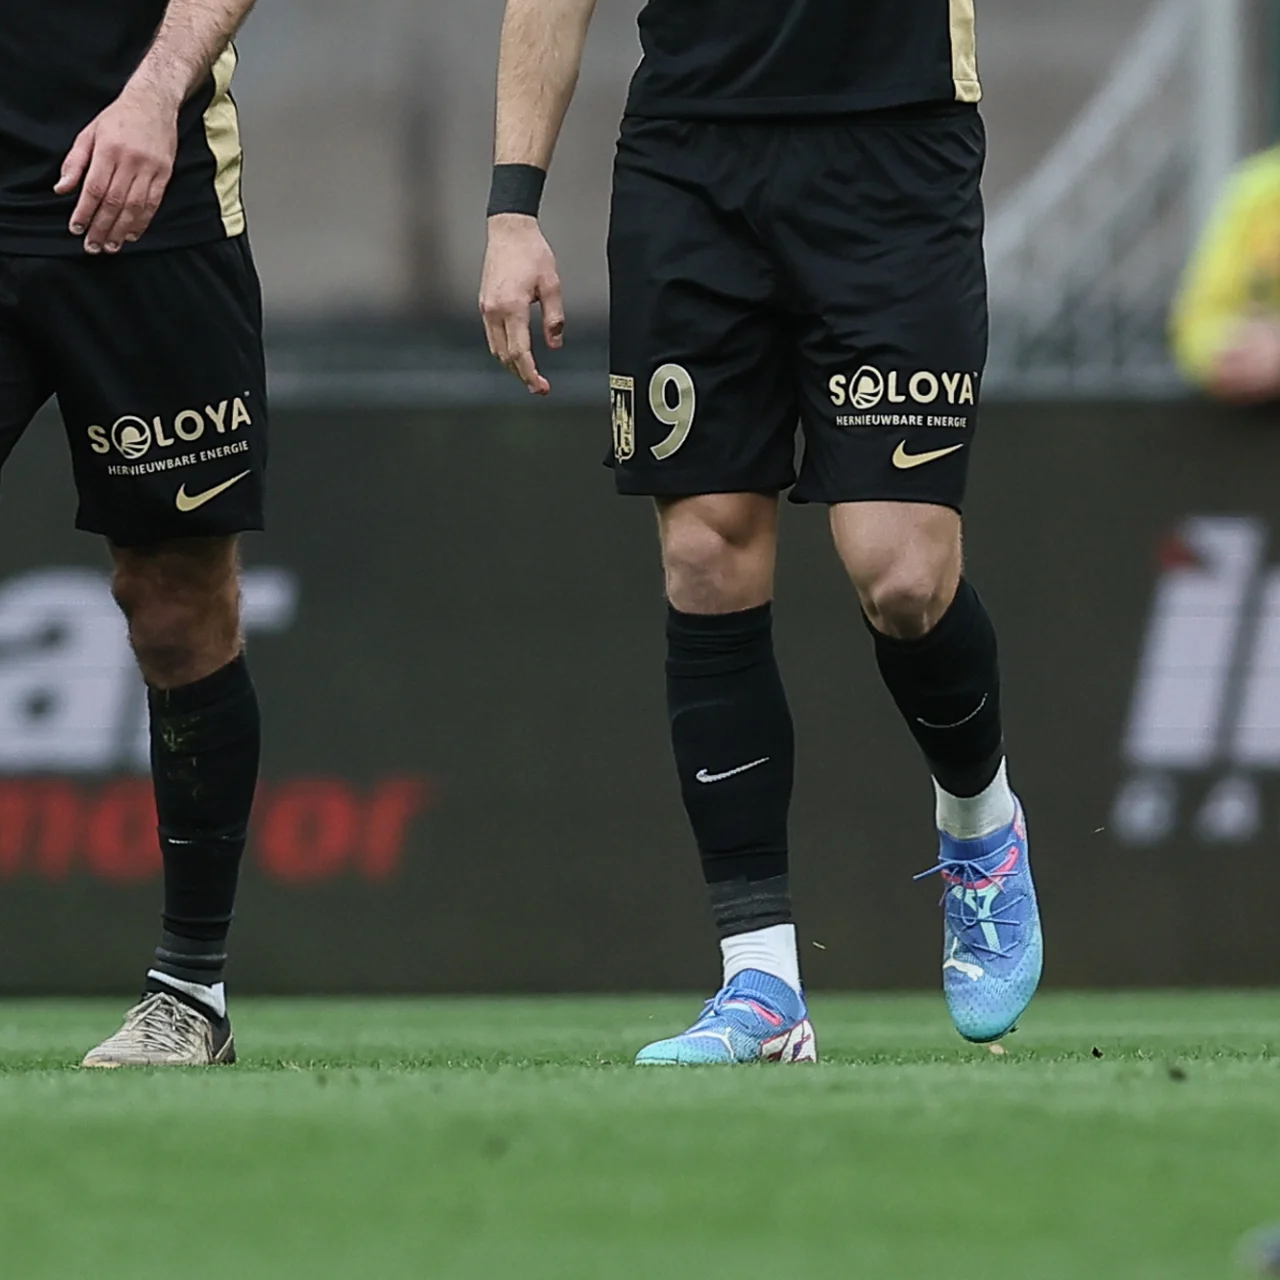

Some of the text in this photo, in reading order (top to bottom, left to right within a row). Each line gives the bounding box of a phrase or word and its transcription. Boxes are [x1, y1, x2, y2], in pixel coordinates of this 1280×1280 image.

[829, 365, 975, 409] SOLOYA
[87, 397, 252, 459] SOLOYA
[649, 363, 696, 460] 9
[836, 414, 968, 428] HERNIEUWBARE ENERGIE
[108, 440, 250, 476] HERNIEUWBARE ENERGIE
